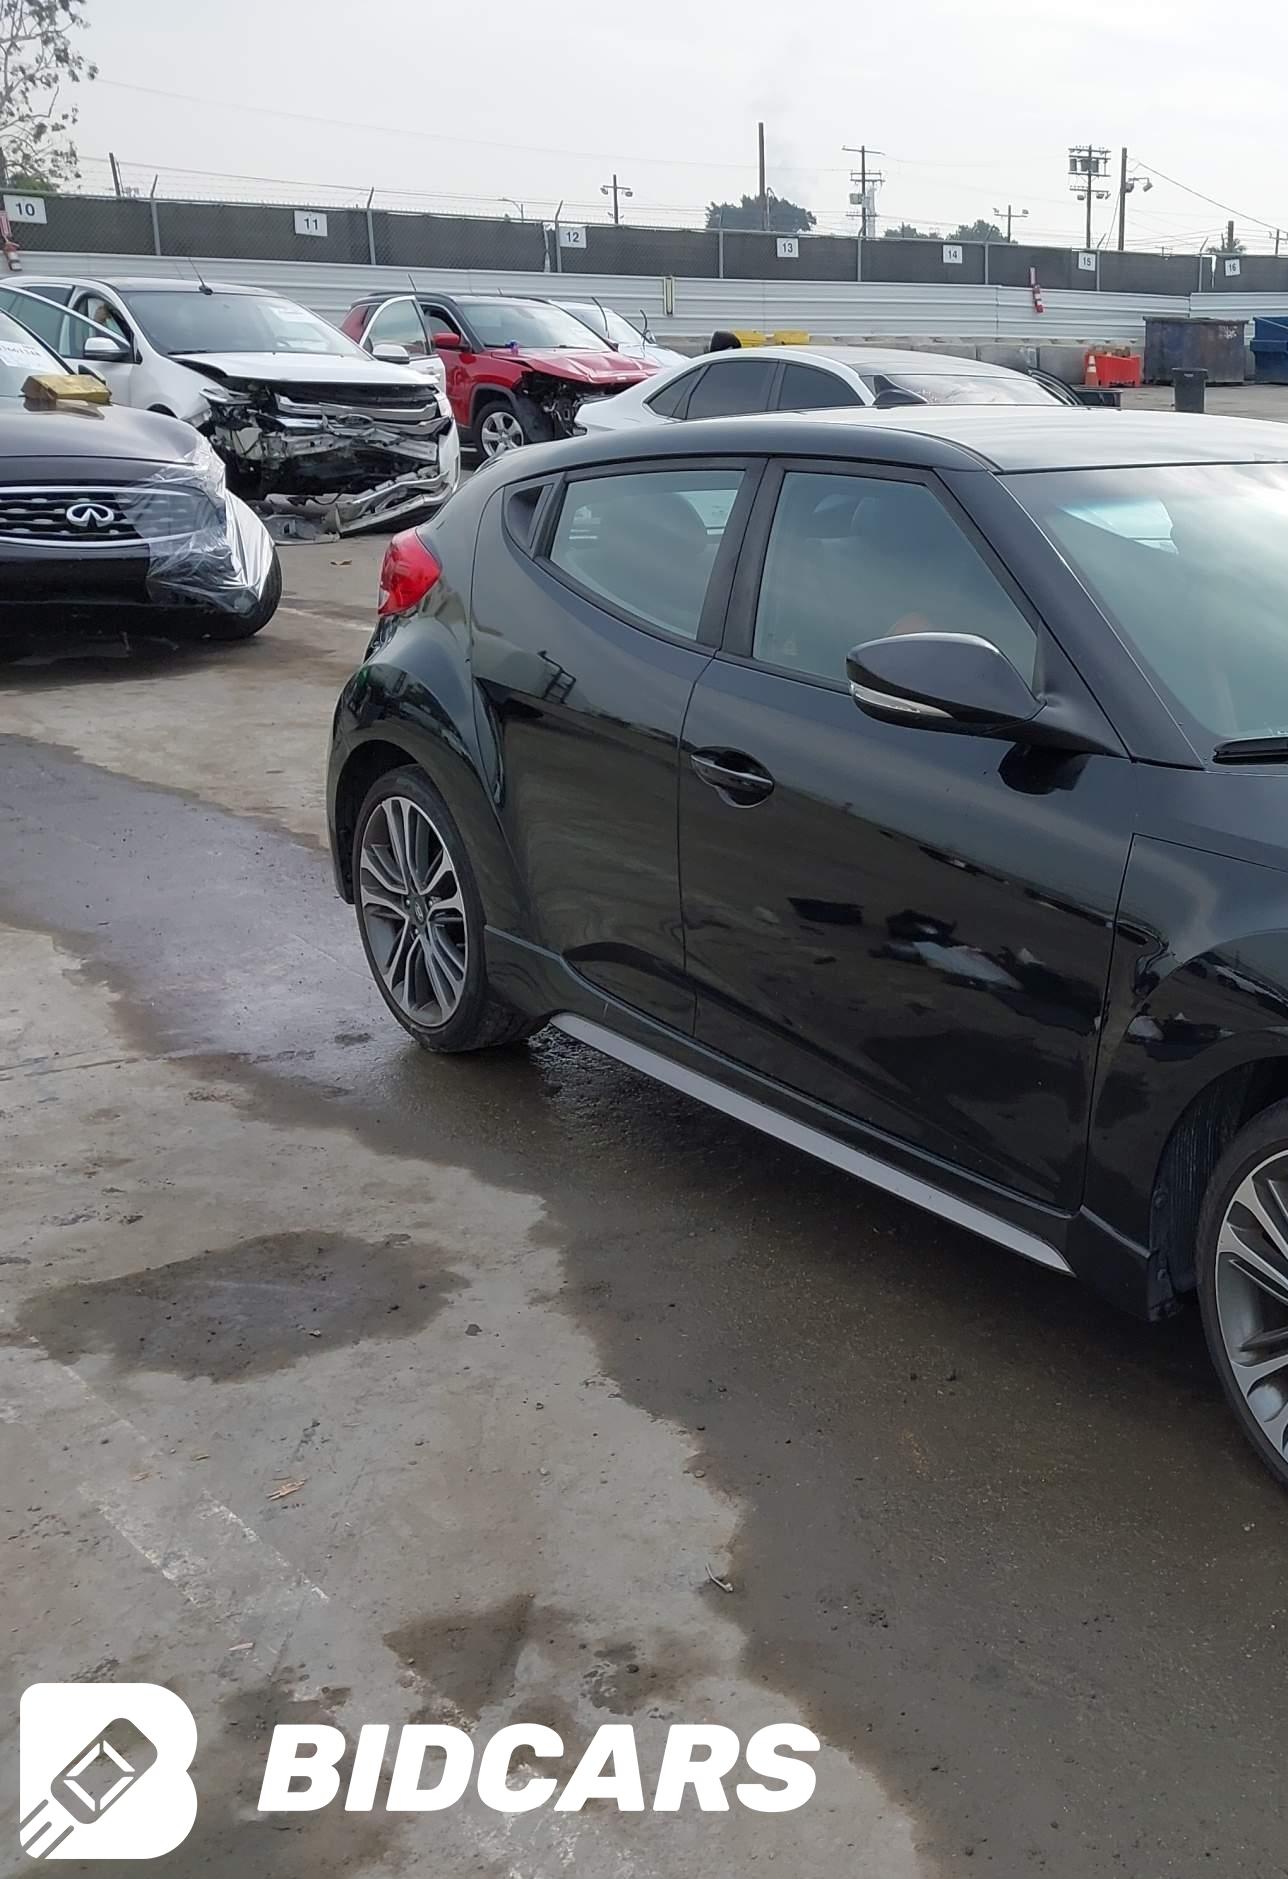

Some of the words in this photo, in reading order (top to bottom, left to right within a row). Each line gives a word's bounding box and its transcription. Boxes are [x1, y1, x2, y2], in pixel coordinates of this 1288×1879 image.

[16, 203, 35, 216] 10
[304, 218, 318, 230] 11
[566, 231, 580, 243] 12
[782, 242, 793, 253] 13
[948, 250, 958, 259] 14
[1082, 256, 1092, 266] 15
[1228, 263, 1237, 273] 16
